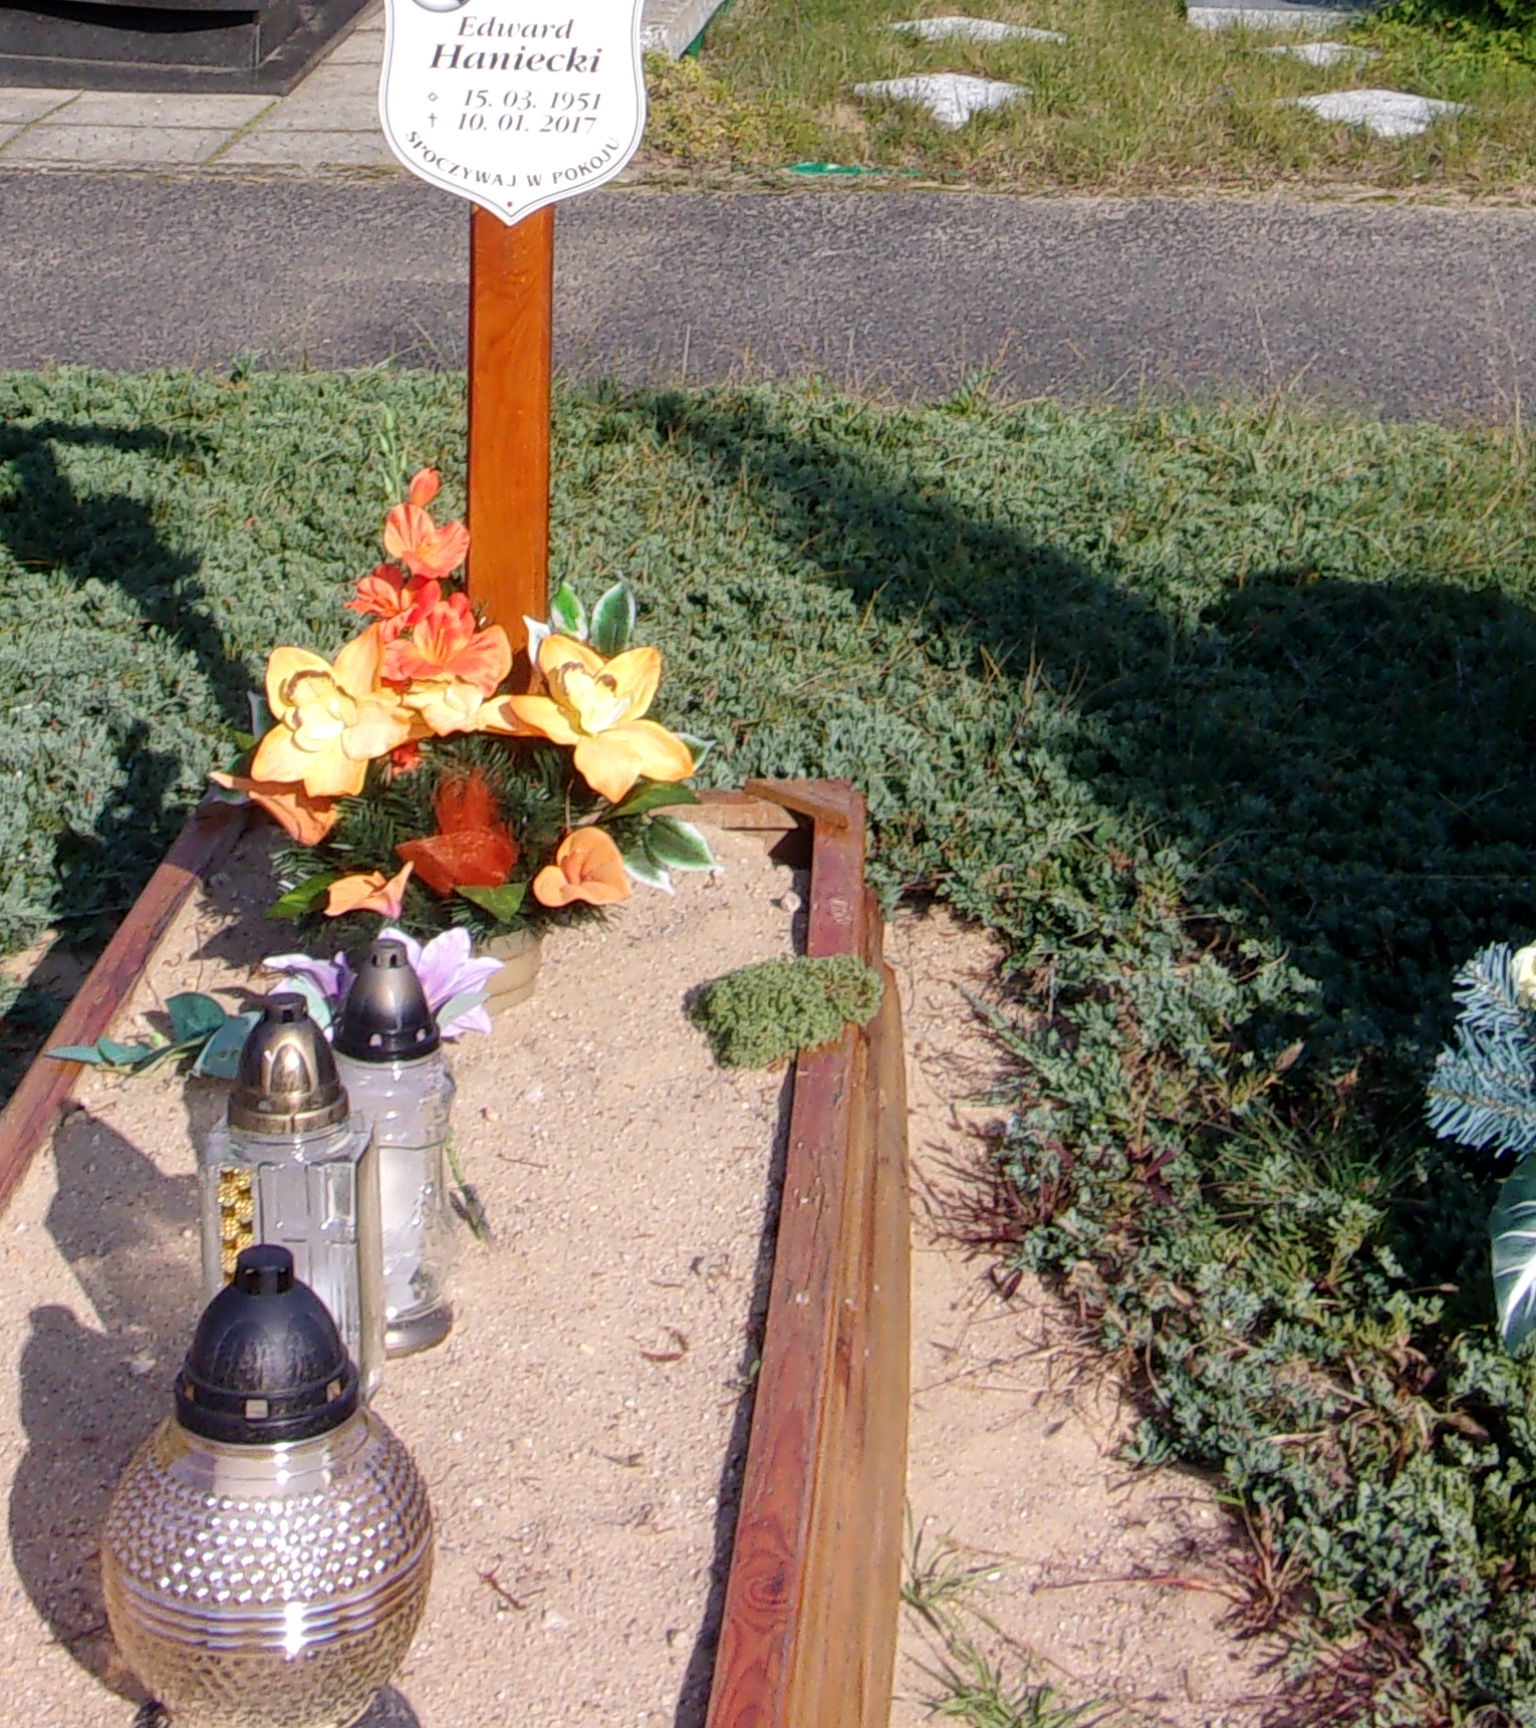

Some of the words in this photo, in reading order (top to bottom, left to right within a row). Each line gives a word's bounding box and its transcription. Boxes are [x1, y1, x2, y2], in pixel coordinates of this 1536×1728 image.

[456, 15, 575, 40] Edward
[427, 43, 604, 74] Haniecki
[463, 88, 494, 109] 15.
[502, 89, 537, 112] 03.
[549, 90, 602, 112] 1951
[457, 112, 488, 132] 10.
[497, 113, 530, 133] 01.
[538, 114, 599, 135] 2017
[406, 129, 518, 188] SPOCZYWAJ
[526, 174, 544, 188] W
[551, 136, 621, 186] POKOJU
